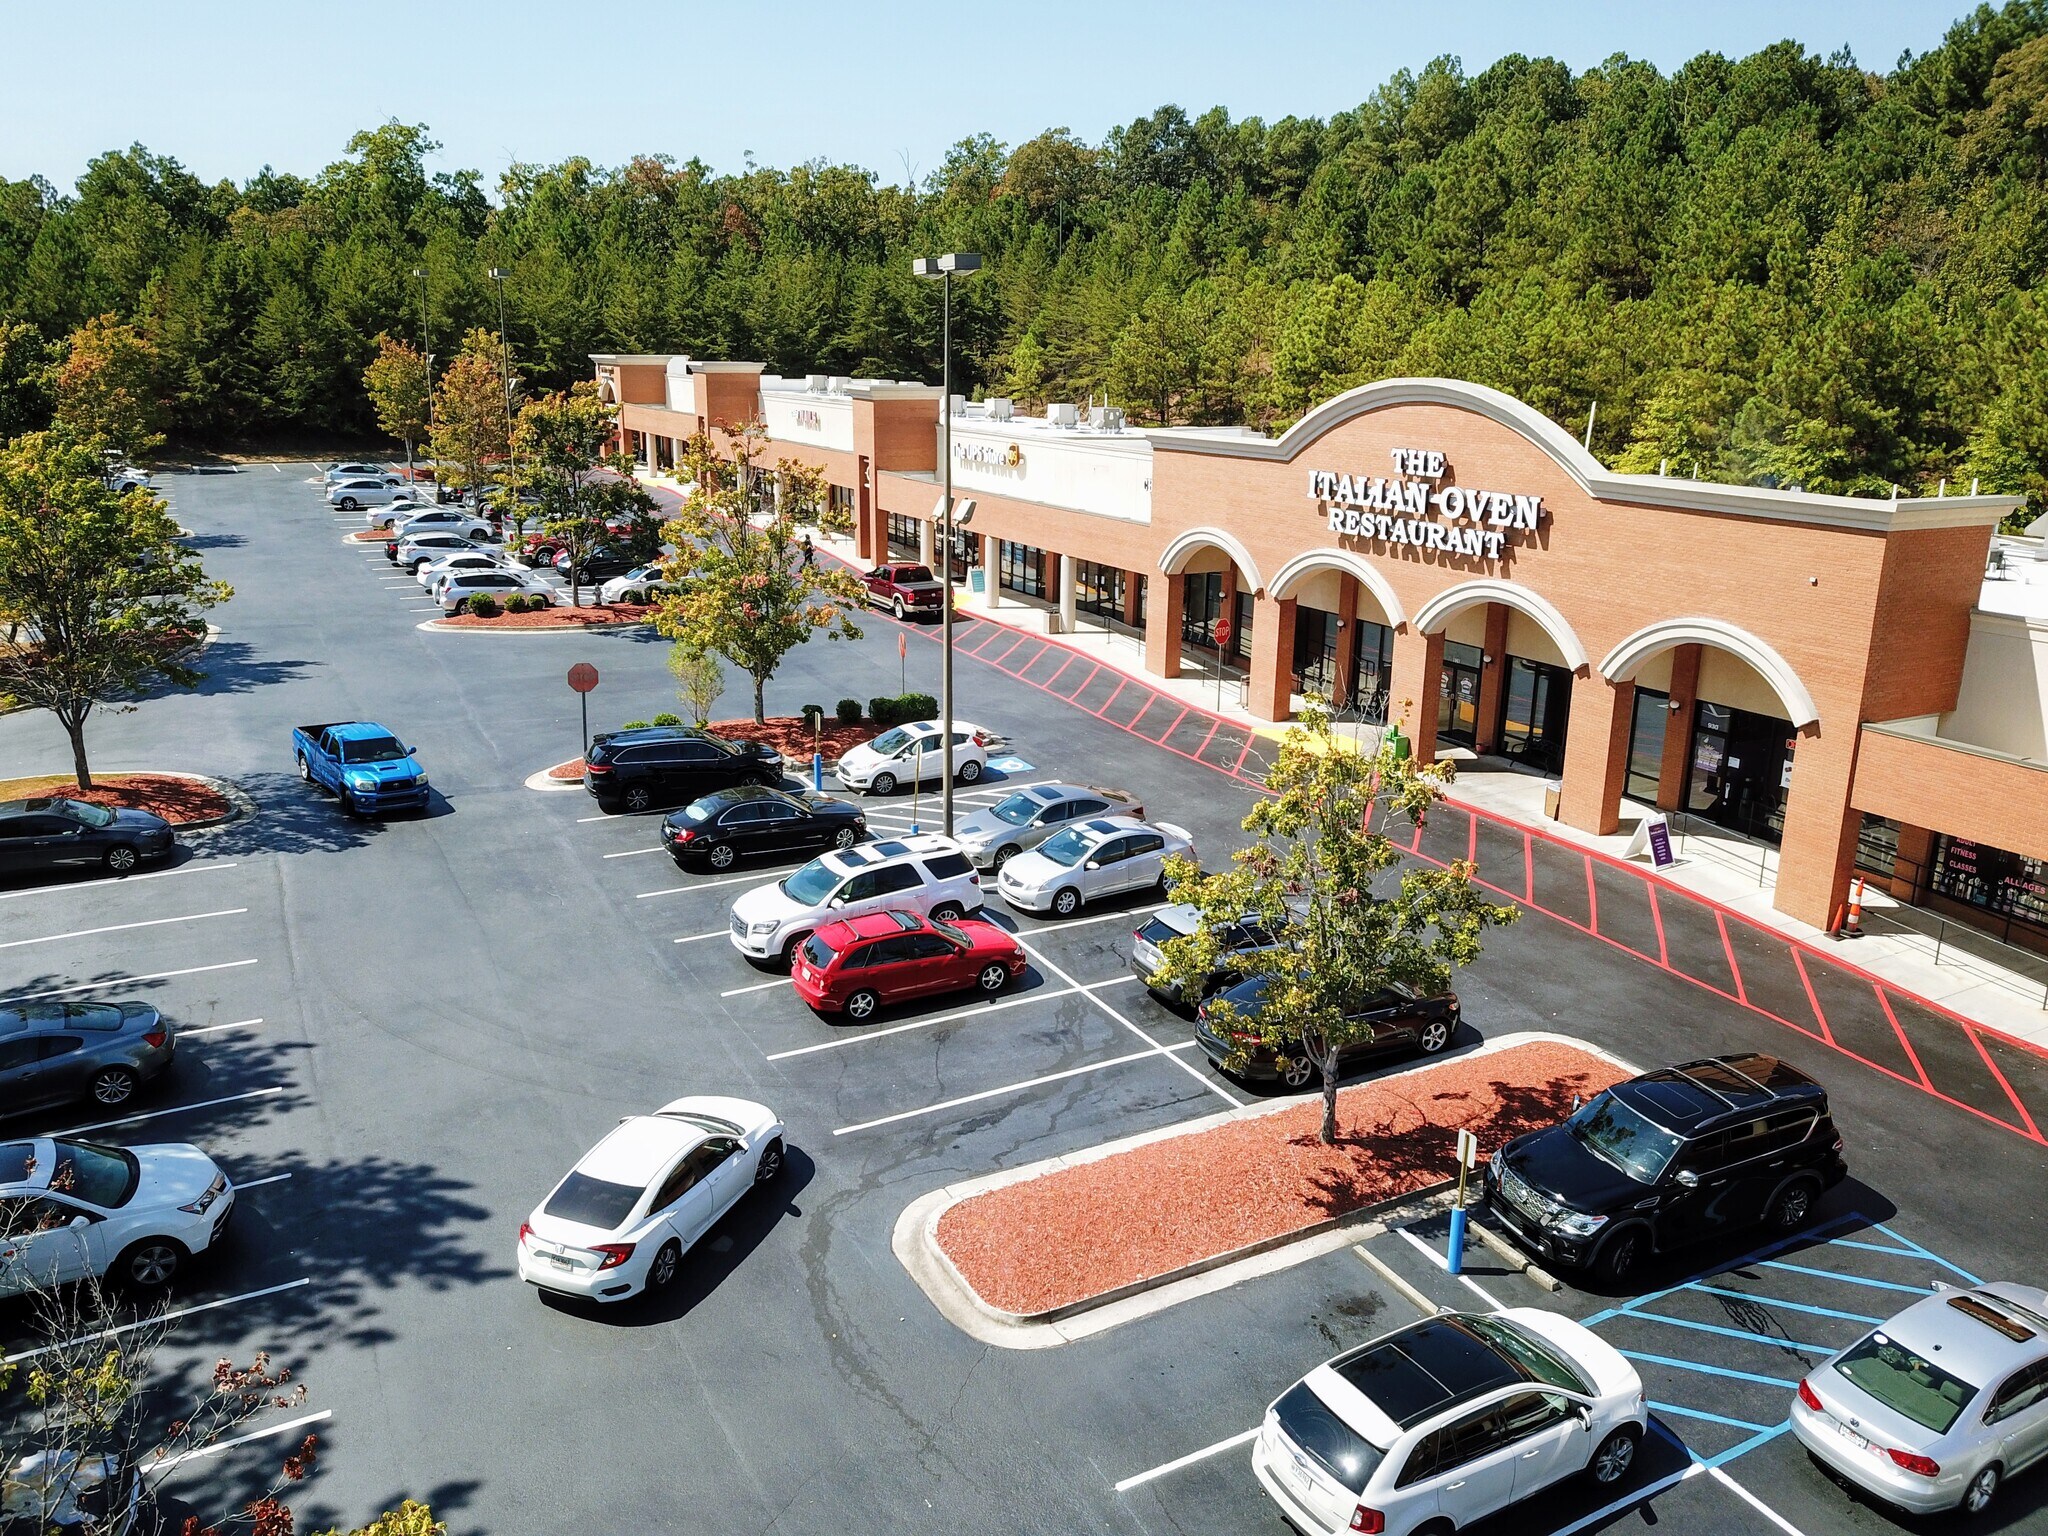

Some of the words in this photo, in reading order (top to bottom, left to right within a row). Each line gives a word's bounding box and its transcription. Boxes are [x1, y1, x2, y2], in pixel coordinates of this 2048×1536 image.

[1391, 448, 1445, 478] THE
[1306, 470, 1431, 515] ITALIAN
[1438, 486, 1541, 531] OVEN
[1327, 507, 1505, 560] RESTAURANT
[1215, 625, 1230, 638] STOP
[1950, 846, 1977, 860] FITNESS
[1949, 860, 1977, 874] CLASSES
[2004, 876, 2020, 887] ALL
[2022, 881, 2046, 895] AGES
